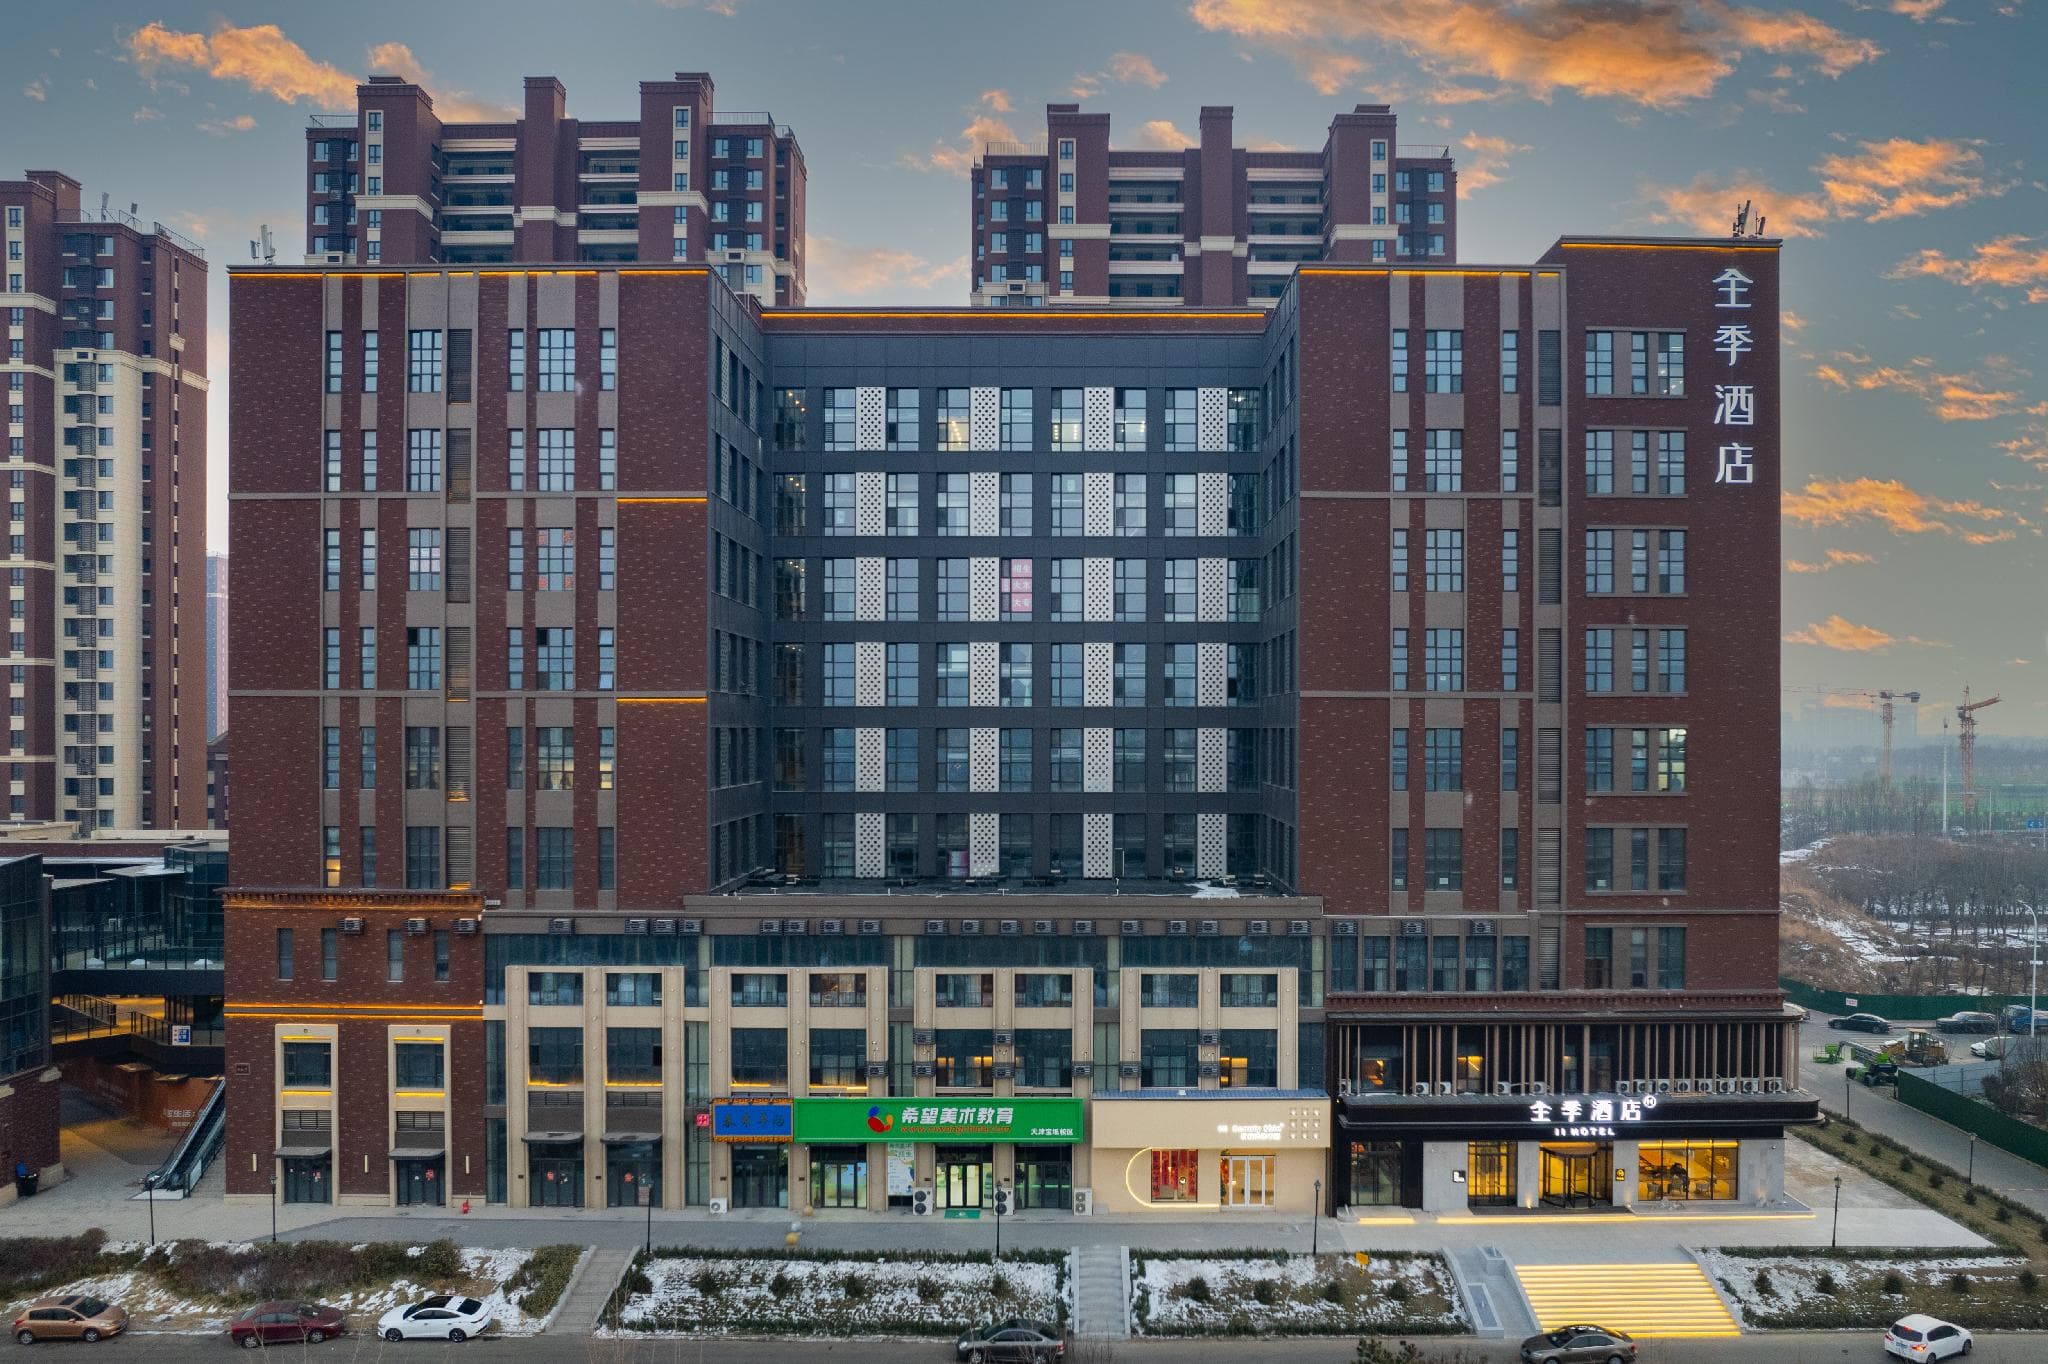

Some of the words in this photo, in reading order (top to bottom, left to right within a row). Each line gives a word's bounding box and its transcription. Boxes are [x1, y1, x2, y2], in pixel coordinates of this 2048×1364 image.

[1712, 268, 1754, 484] 全季酒店
[901, 1107, 1014, 1125] 希望美术教育
[1529, 1099, 1641, 1122] 全季酒店
[1570, 1126, 1615, 1136] HOTEL
